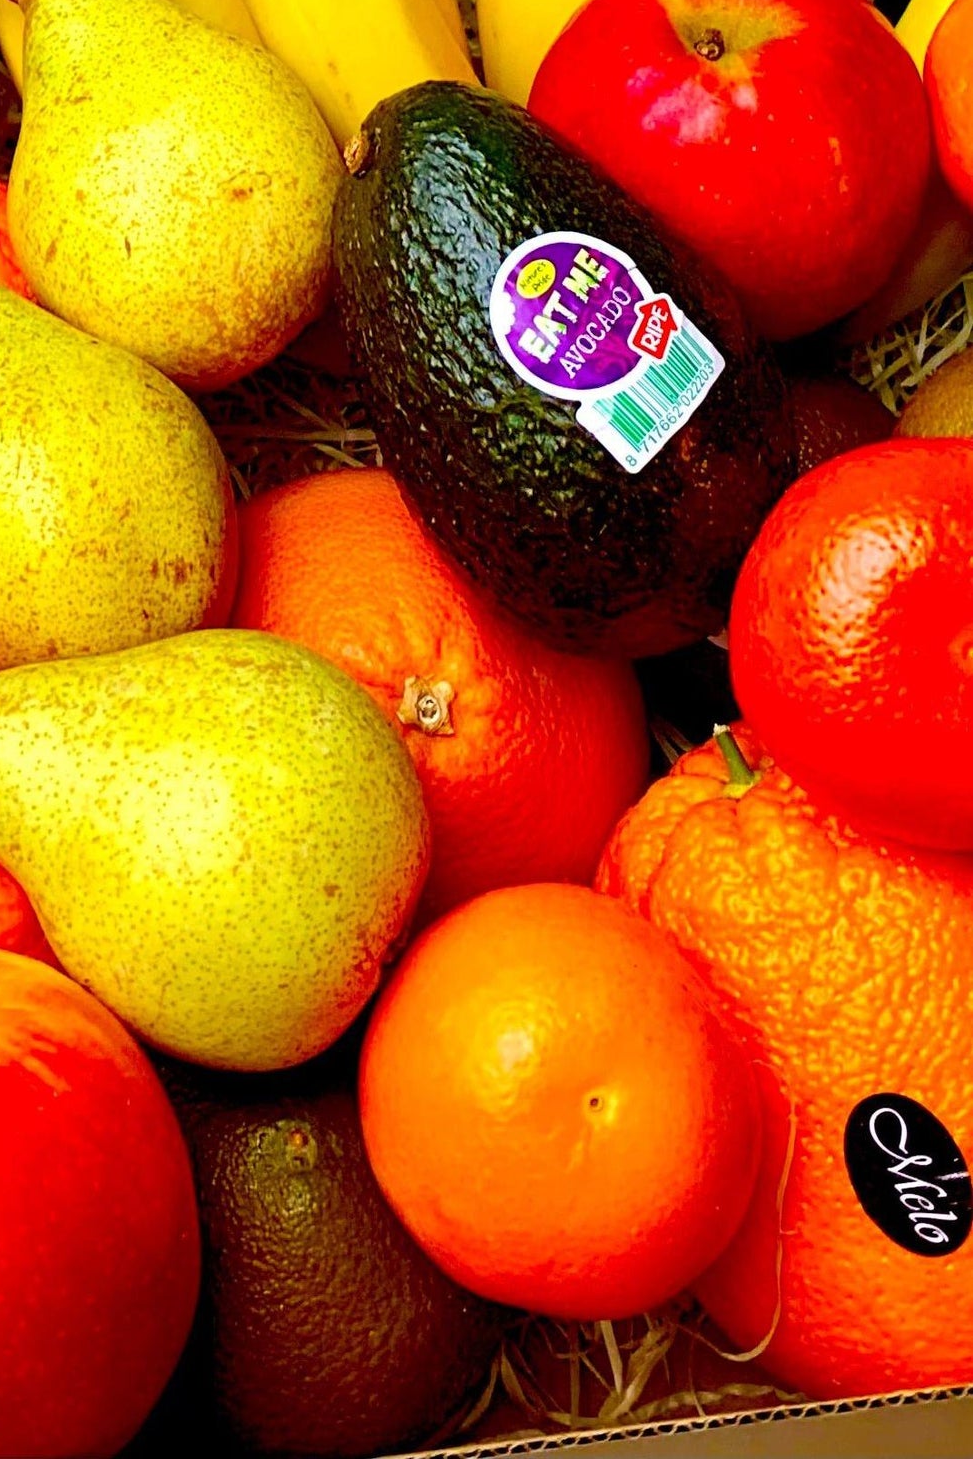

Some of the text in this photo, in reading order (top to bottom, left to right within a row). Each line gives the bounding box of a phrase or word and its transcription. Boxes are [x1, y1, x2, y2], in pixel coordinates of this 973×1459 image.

[517, 248, 611, 364] EAT ME
[558, 286, 632, 380] AVOCADO
[640, 304, 669, 352] RIPE
[869, 1107, 958, 1244] Melo
